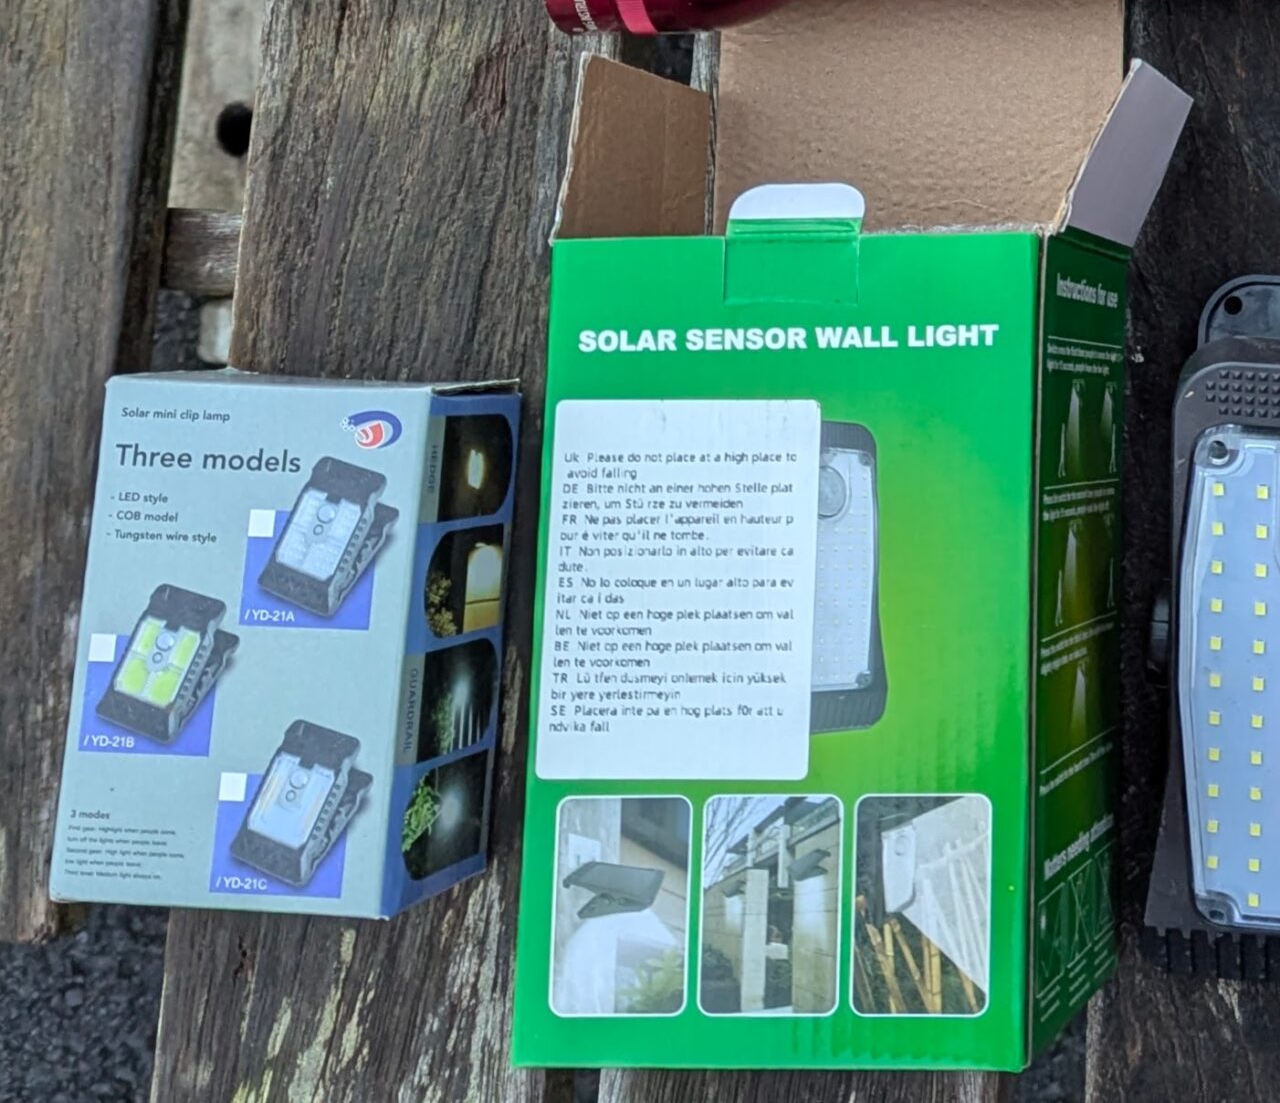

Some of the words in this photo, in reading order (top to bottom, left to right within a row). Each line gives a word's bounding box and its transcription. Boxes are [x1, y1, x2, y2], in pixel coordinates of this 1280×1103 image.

[1056, 272, 1096, 304] Instructions
[1097, 283, 1106, 306] for
[1107, 291, 1119, 309] use
[578, 329, 677, 353] SOLAR
[685, 327, 808, 351] SENSOR
[815, 325, 898, 349] WALL
[907, 324, 999, 347] LIGHT
[121, 407, 150, 418] Solar
[153, 408, 176, 419] mini
[180, 409, 199, 422] clip
[203, 410, 230, 423] lamp
[116, 443, 192, 469] Three
[203, 448, 301, 473] models
[587, 452, 624, 463] Please
[627, 452, 641, 463] do
[645, 453, 662, 463] not
[665, 452, 696, 464] place
[700, 453, 711, 463] at
[714, 454, 721, 463] a
[724, 452, 748, 465] high
[751, 452, 782, 464] place
[427, 444, 439, 494] HEDGE
[567, 467, 598, 478] avoid
[562, 483, 578, 494] DE
[587, 483, 614, 494] Bitte
[617, 483, 645, 494] nicht
[649, 484, 663, 494] an
[118, 491, 140, 502] LED
[143, 493, 168, 505] style
[604, 500, 621, 509] um
[669, 500, 682, 509] zu
[685, 498, 744, 509] vermeiden
[116, 510, 141, 521] COB
[144, 512, 178, 522] model
[562, 514, 577, 525] FR
[602, 516, 622, 526] pas
[626, 513, 661, 525] placer
[723, 516, 737, 525] en
[114, 528, 162, 542] Tungsten
[166, 531, 189, 542] wire
[192, 533, 217, 545] style
[653, 531, 667, 541] ne
[579, 546, 601, 557] Non
[676, 545, 687, 556] in
[690, 545, 712, 556] alto
[737, 545, 777, 557] evitare
[559, 577, 573, 588] ES
[661, 578, 674, 588] en
[677, 578, 691, 588] un
[580, 609, 602, 620] Niet
[623, 610, 643, 620] een
[577, 625, 588, 636] te
[554, 640, 570, 652] BE
[578, 640, 600, 651] Niet
[622, 642, 642, 652] een
[574, 657, 586, 668] te
[553, 672, 568, 683] TR
[403, 668, 419, 754] GUARDRAIL
[550, 705, 567, 716] SE
[79, 809, 110, 819] modes
